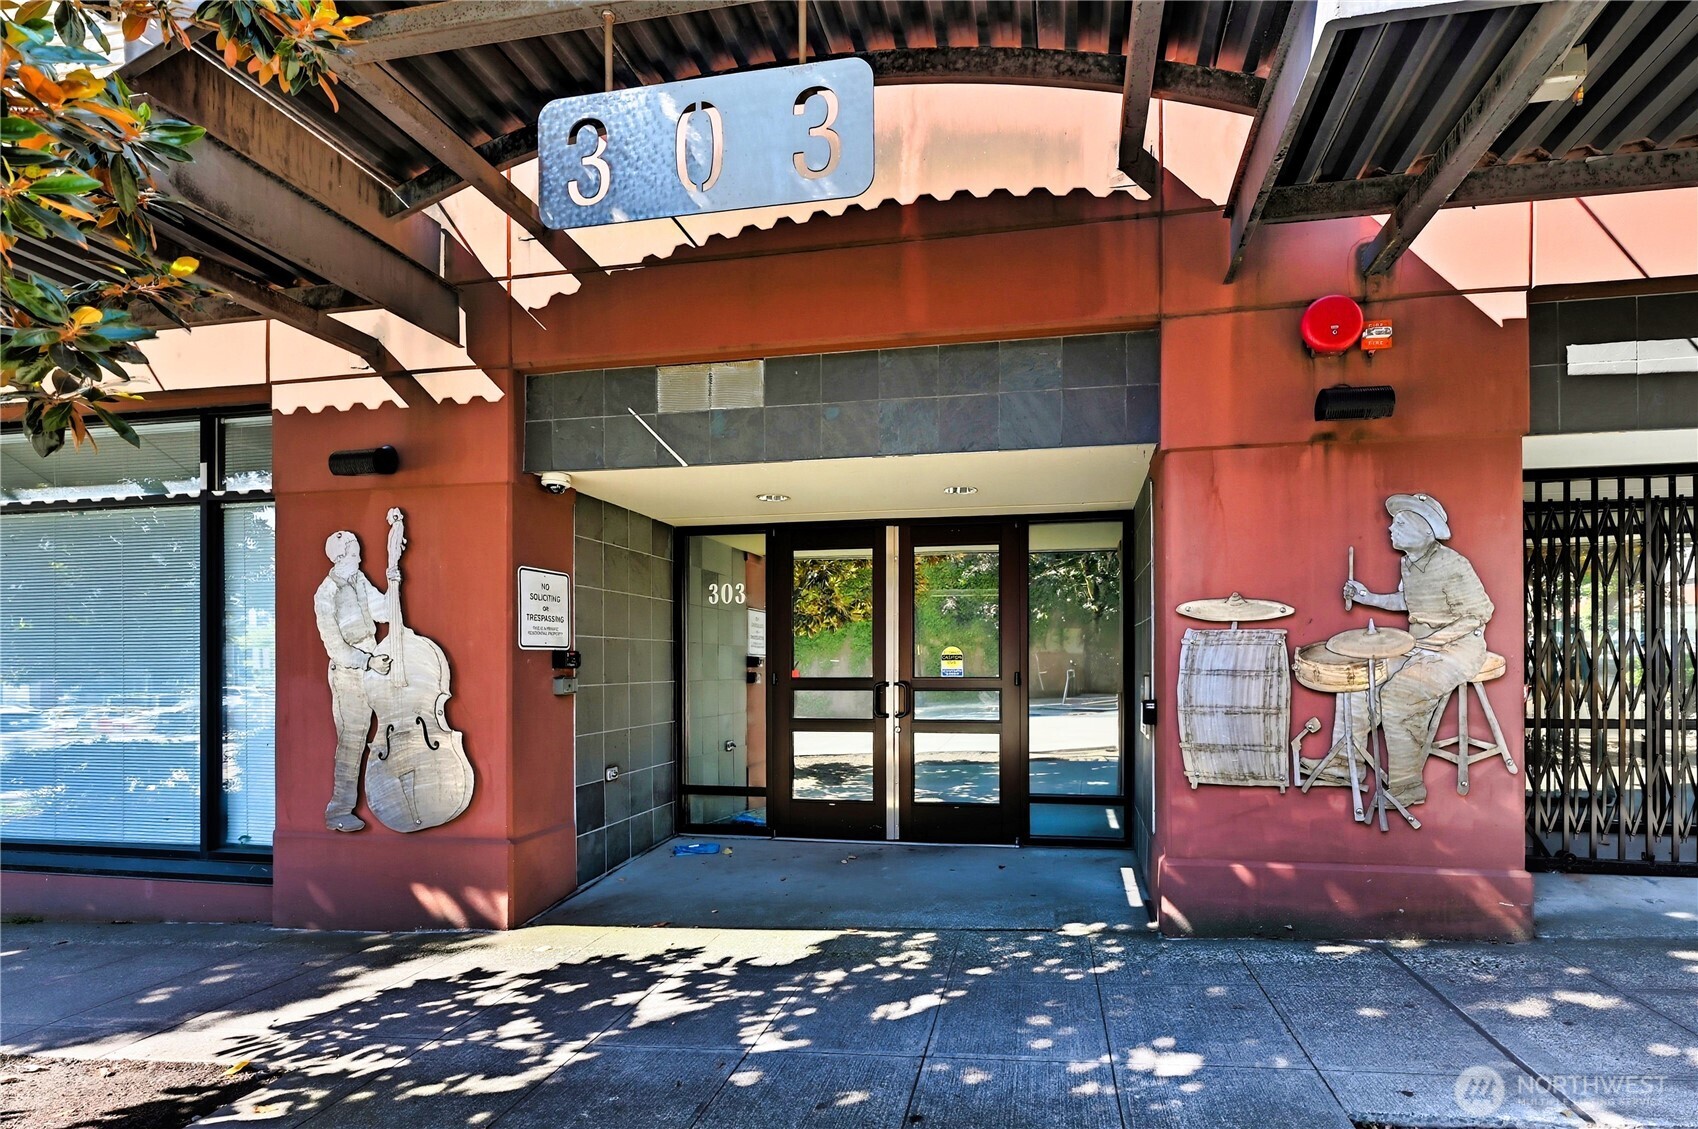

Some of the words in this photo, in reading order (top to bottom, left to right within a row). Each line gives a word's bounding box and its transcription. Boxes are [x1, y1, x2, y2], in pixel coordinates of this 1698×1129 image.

[567, 86, 842, 207] 303
[541, 583, 550, 591] NO
[529, 592, 561, 603] SOLICITING
[708, 583, 746, 605] 303
[526, 613, 565, 624] TRESPASSING
